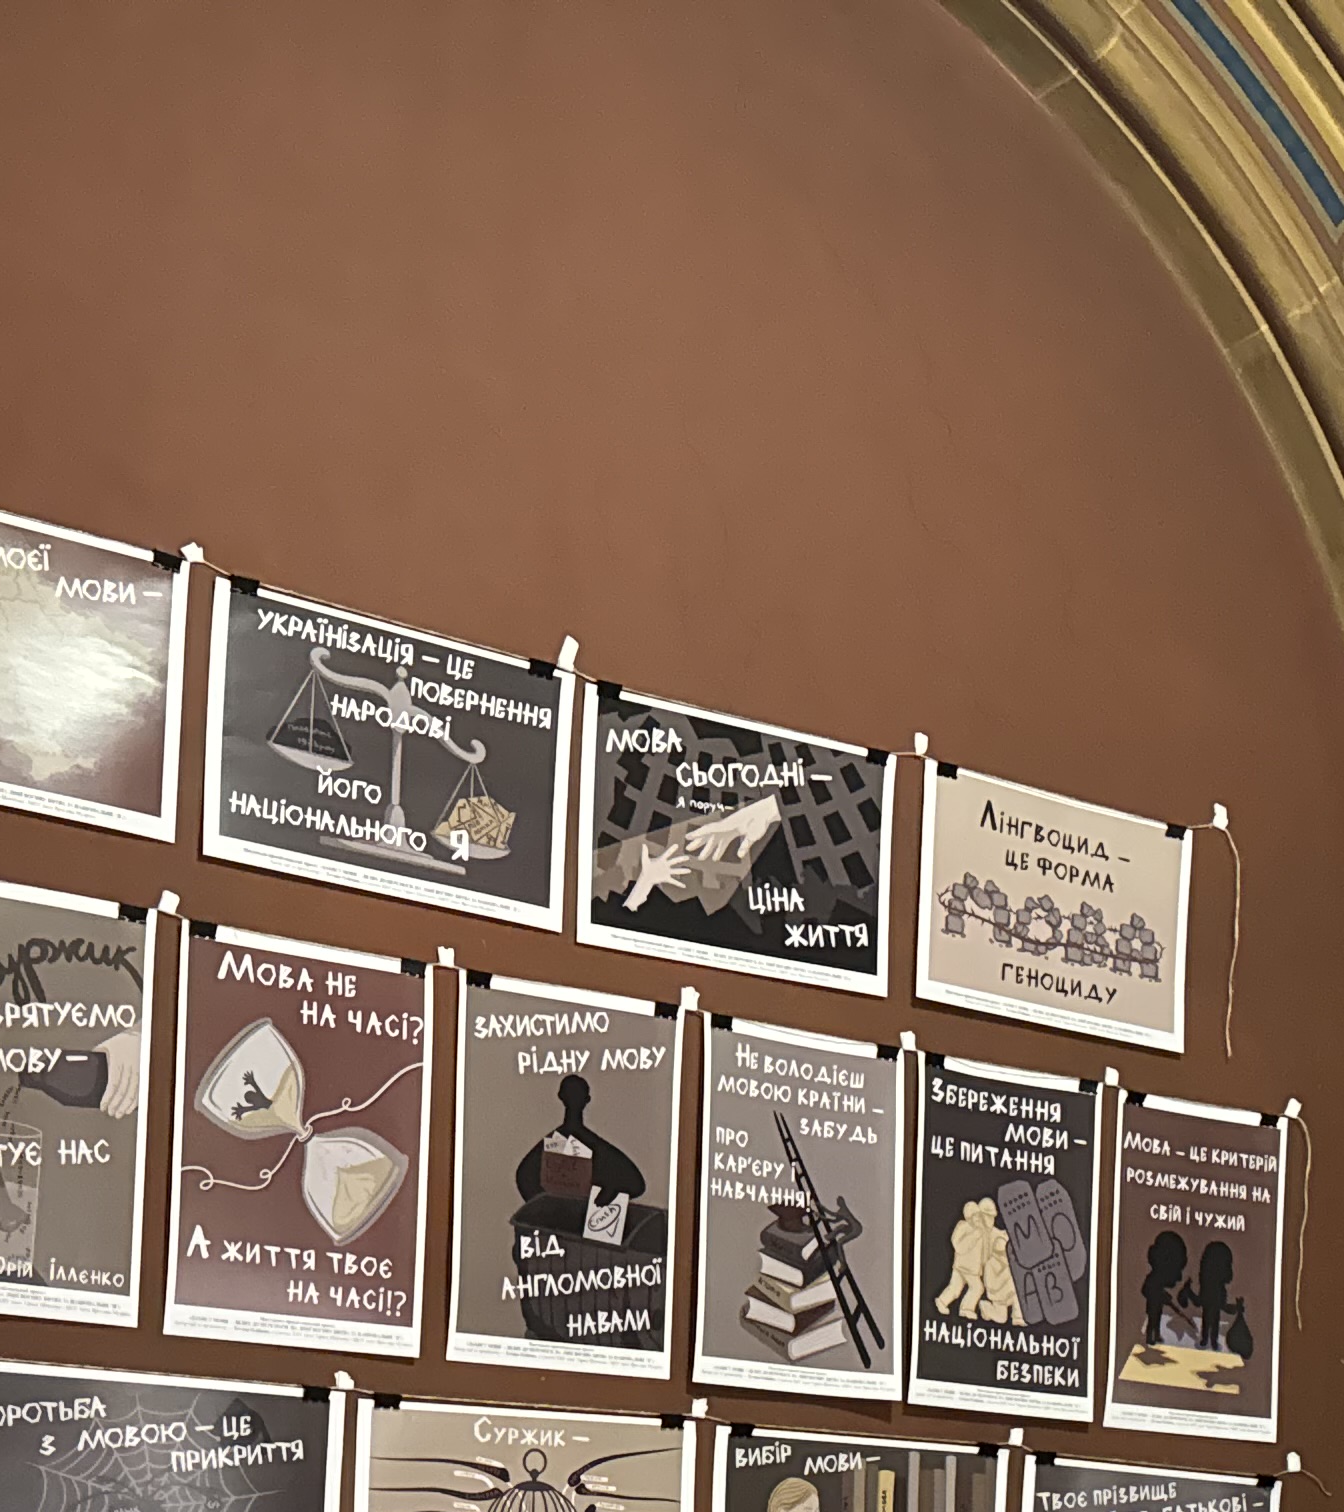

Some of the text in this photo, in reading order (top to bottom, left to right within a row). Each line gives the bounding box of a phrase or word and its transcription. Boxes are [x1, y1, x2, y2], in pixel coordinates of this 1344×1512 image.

[56, 576, 135, 605] МОВИ
[257, 608, 414, 666] УКРАЇНІЗАЦІЯ
[330, 694, 452, 741] НАРОДОВІ
[410, 676, 552, 730] ПОВЕРНЕННЯ
[605, 727, 683, 753] МОВА
[317, 765, 382, 804] ЙОГО
[675, 758, 805, 788] СЬОГОДНІ
[228, 790, 427, 852] НАЦІОНАЛЬНОГО
[1037, 857, 1115, 893] ФОРМА
[748, 882, 805, 915] ЦІНА
[784, 922, 869, 948] ЖИТТЯ
[1001, 963, 1118, 1005] ГЕНОЦИДУ
[473, 1010, 610, 1040] ЗАХИСТИМО
[517, 1045, 667, 1076] РІДНУ МОВУ
[763, 1054, 865, 1089] ВОЛОДІЄШ
[717, 1074, 866, 1114] МОВОЮ КРАЇНИ
[930, 1077, 1062, 1124] ЗБЕРЕЖЕННЯ
[715, 1126, 749, 1148] ПРО
[800, 1117, 878, 1145] ЗАБУДЬ
[1004, 1123, 1069, 1150] МОВИ
[57, 1138, 111, 1166] НАС
[959, 1141, 1056, 1176] ПИТАННЯ
[1189, 1146, 1208, 1163] ЦЕ
[710, 1177, 812, 1213] НАВЧАННЯ!
[1126, 1166, 1271, 1204] РОЗМЕЖУВАННЯ НА
[1194, 1211, 1246, 1232] ЧУЖИЙ
[221, 1238, 394, 1280] ЖИТТЯ ТВОЄ
[519, 1231, 565, 1260] ВІД
[501, 1256, 663, 1302] АНГЛОМОВНОЇ
[566, 1307, 650, 1338] НАВАЛИ
[923, 1319, 1081, 1360] НАЦІОНАЛЬНОЇ
[996, 1360, 1080, 1388] БЕЗПЕКИ
[77, 1421, 187, 1452] МОВОЮ
[171, 1439, 305, 1473] ПРИКРИТТЯ
[734, 1441, 792, 1469] ВИБІР
[803, 1452, 863, 1476] МОВИ
[1036, 1481, 1178, 1512] ТВОЄ ПРІЗВИЩЕ
